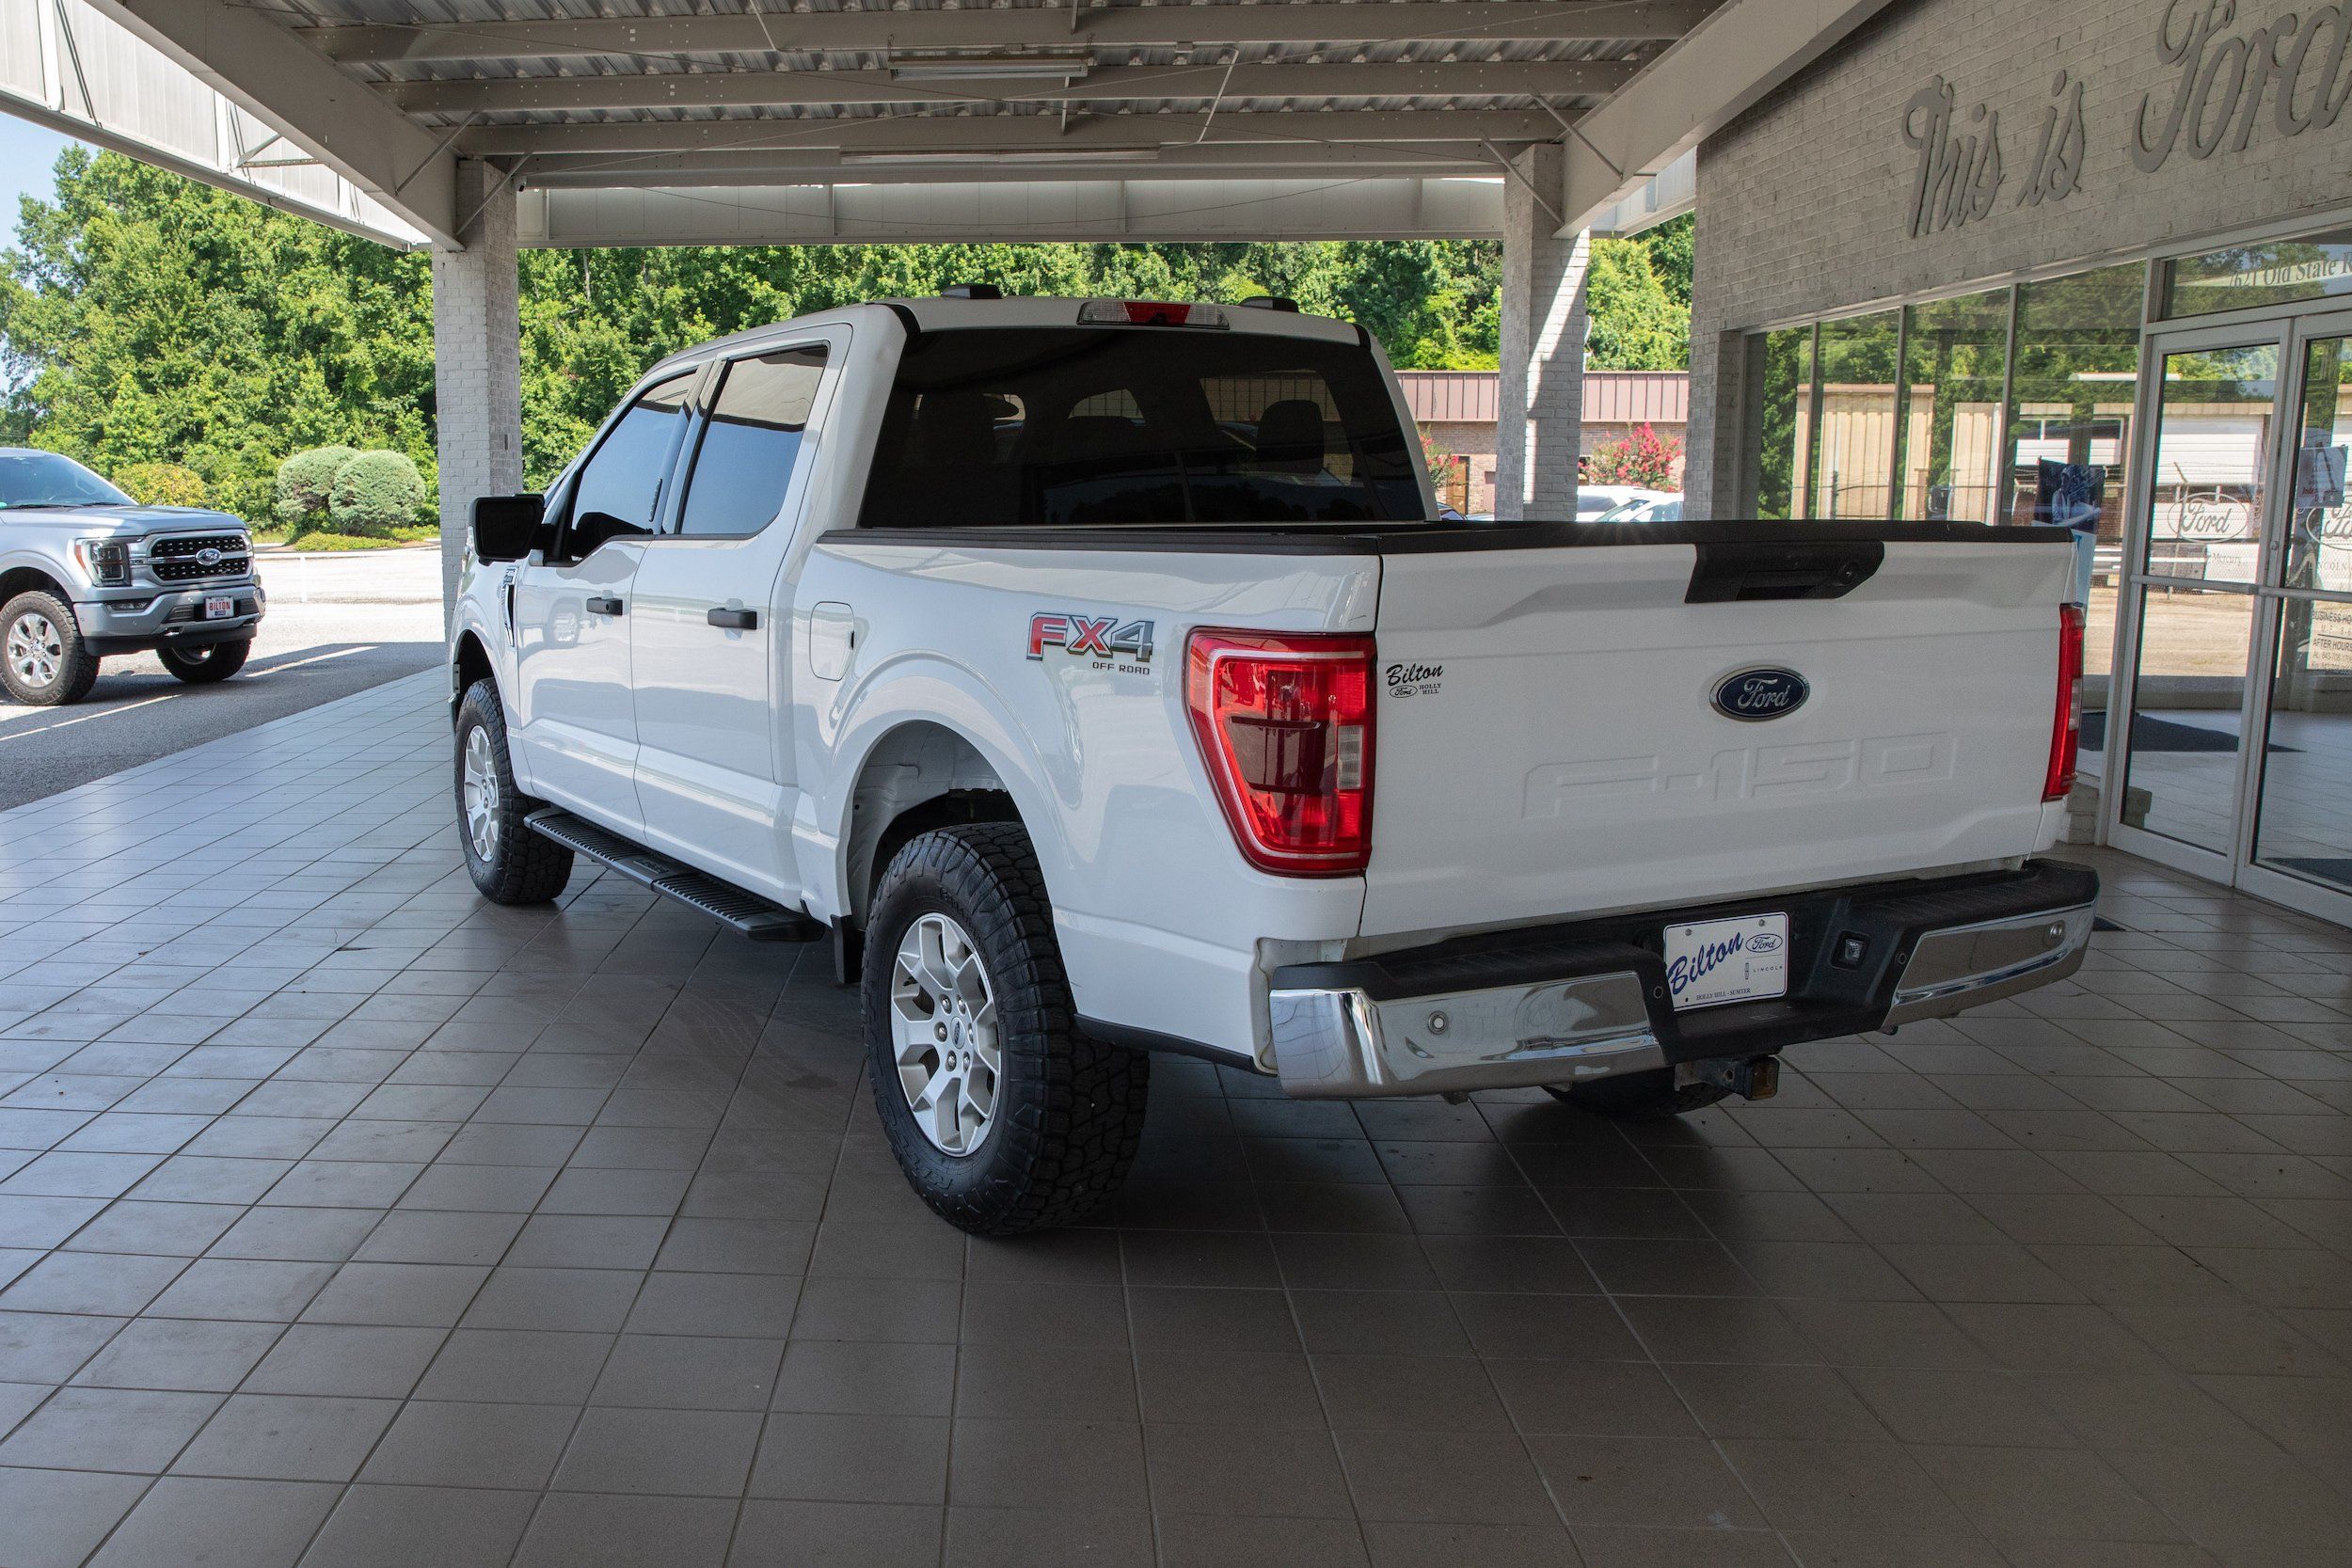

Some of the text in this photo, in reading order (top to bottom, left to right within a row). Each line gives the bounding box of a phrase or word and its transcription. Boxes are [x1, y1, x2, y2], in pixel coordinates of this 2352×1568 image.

[1901, 74, 2005, 239] This
[2016, 69, 2084, 206] is
[2264, 264, 2291, 285] Old
[2296, 257, 2337, 280] State
[2182, 498, 2232, 532] Ford
[2213, 552, 2242, 567] Mercury
[209, 601, 231, 610] BILTON
[1026, 612, 1154, 662] FX4
[2312, 638, 2332, 649] AFTER
[1092, 661, 1150, 675] OFF ROAD
[1386, 662, 1444, 687] Bilton
[1394, 687, 1413, 696] Ford
[1737, 677, 1790, 709] Ford
[1521, 731, 1959, 820] F-150
[1668, 931, 1776, 995] Bilton Ford
[1696, 991, 1714, 1001] HOLLY
[1714, 990, 1727, 999] HILL
[1730, 988, 1751, 996] SUMTER
